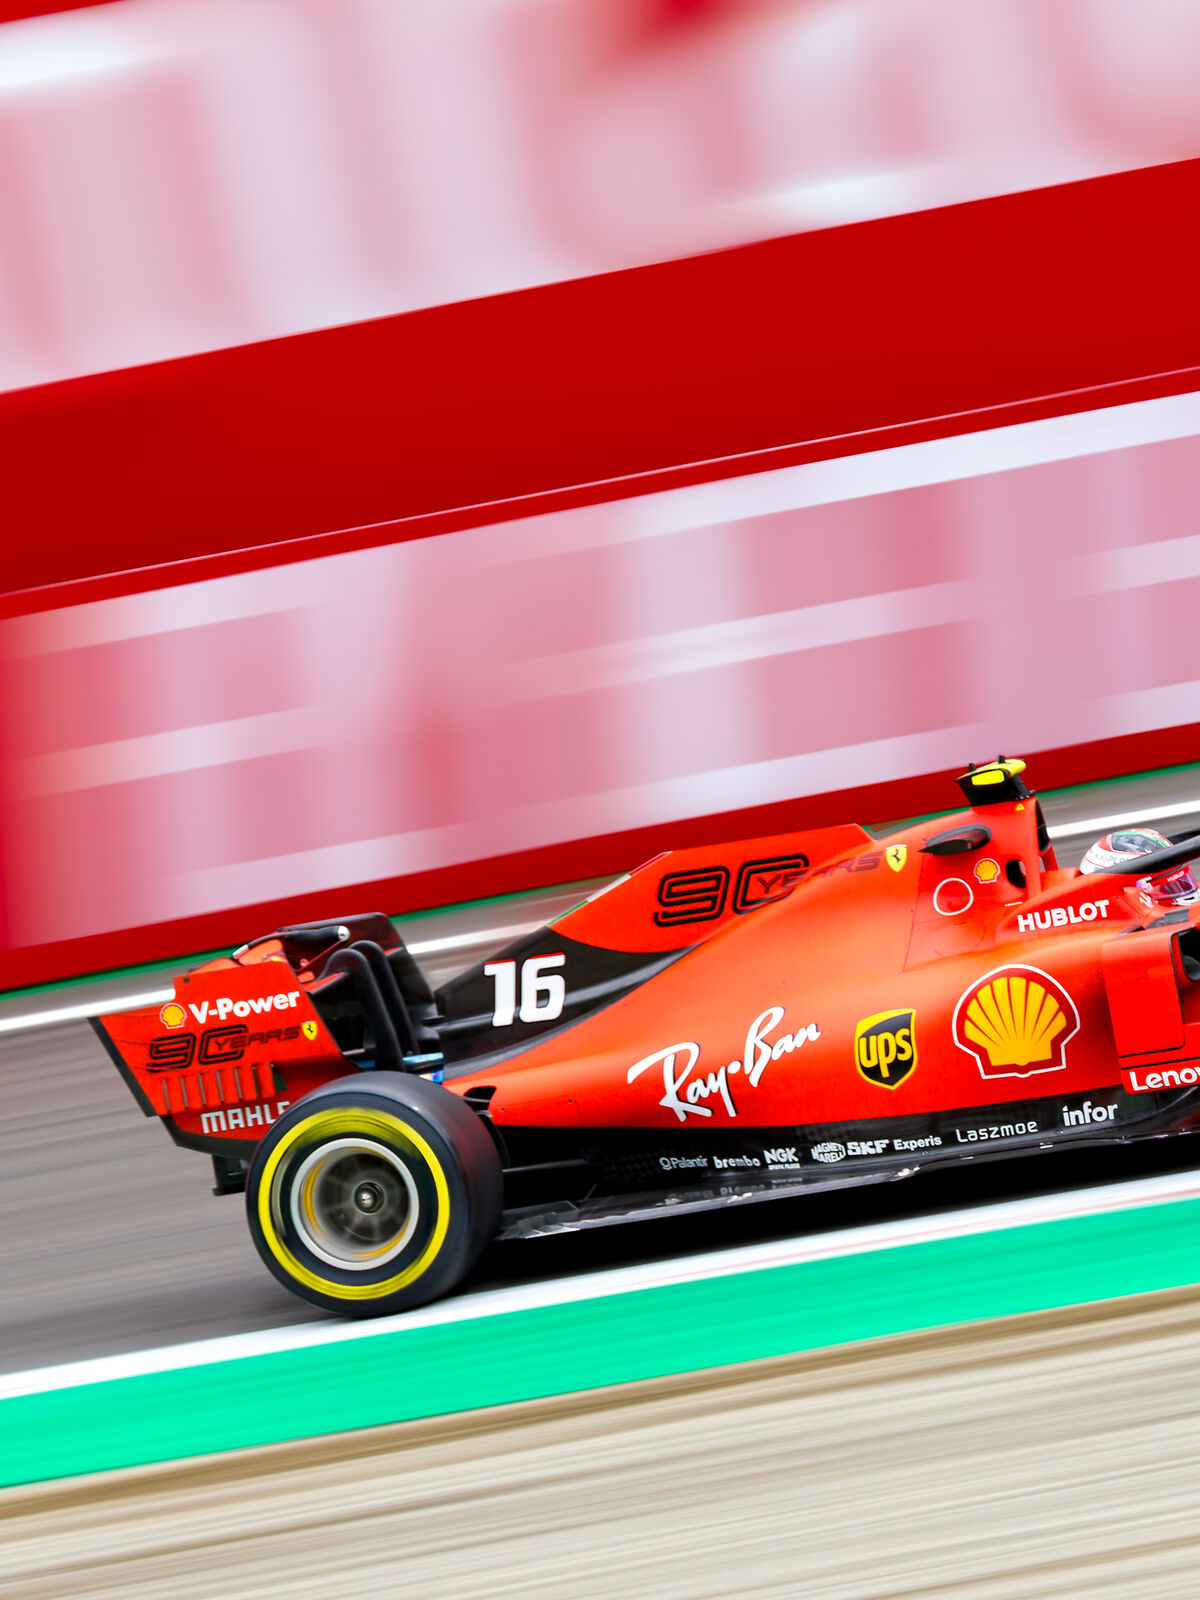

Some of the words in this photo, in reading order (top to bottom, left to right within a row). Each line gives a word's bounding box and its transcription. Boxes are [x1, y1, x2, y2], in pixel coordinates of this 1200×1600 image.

[653, 853, 809, 928] 90
[1016, 899, 1110, 933] HUBLOT
[484, 952, 565, 1027] 16
[188, 991, 300, 1024] V-Power
[146, 1024, 248, 1073] 90
[213, 1026, 301, 1051] YEARS
[858, 1028, 913, 1078] ups
[1062, 1101, 1119, 1127] infor
[763, 1147, 799, 1165] NGK
[846, 1139, 890, 1156] SKF
[893, 1135, 943, 1152] Experis
[669, 1156, 708, 1169] Palantir
[712, 1155, 761, 1169] brembo
